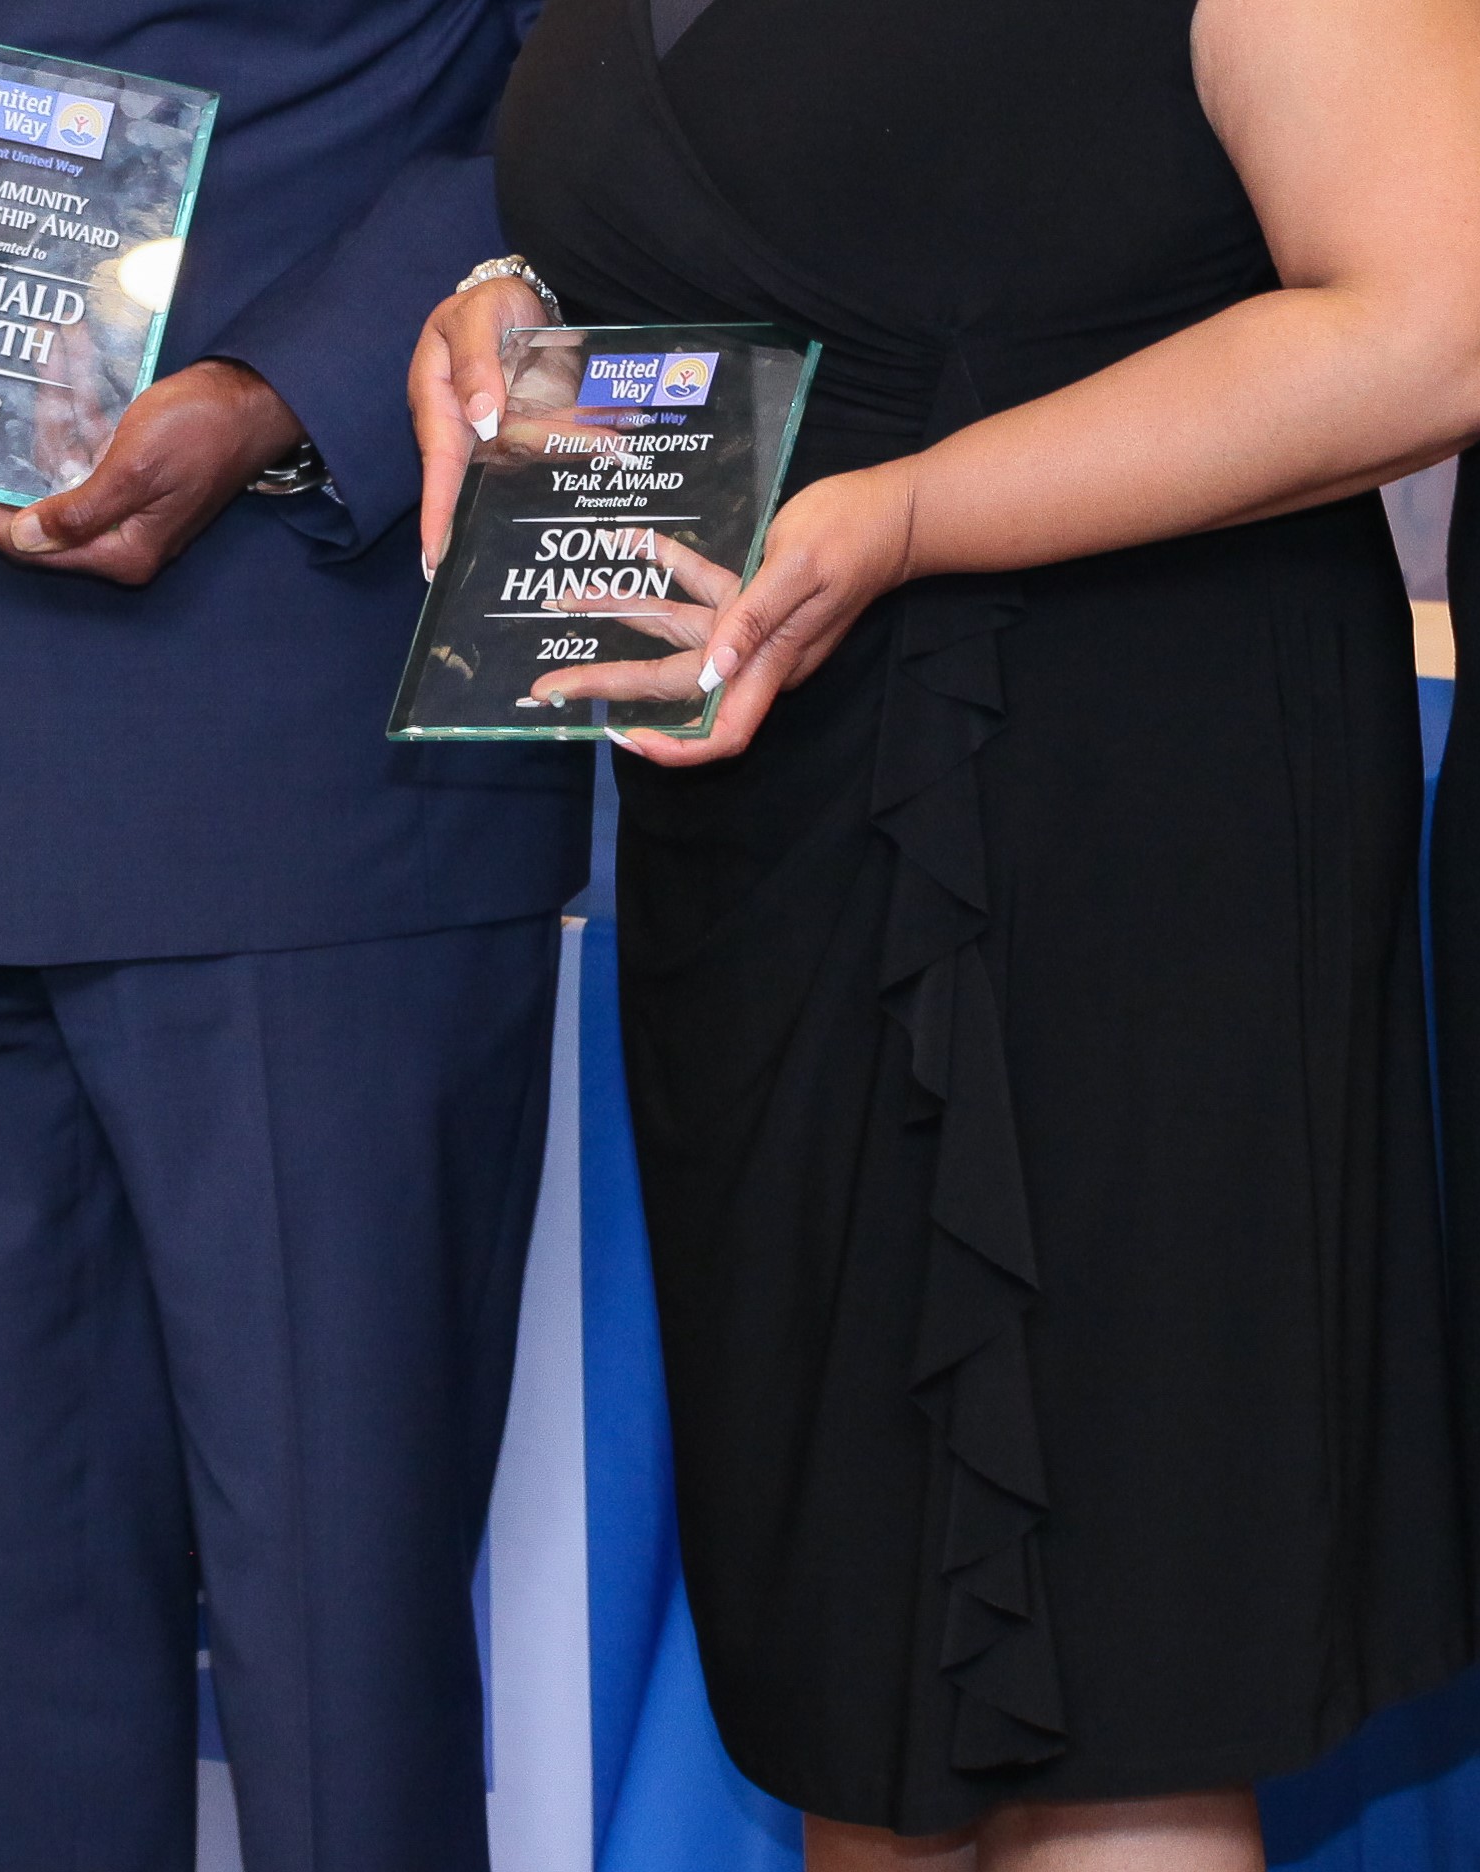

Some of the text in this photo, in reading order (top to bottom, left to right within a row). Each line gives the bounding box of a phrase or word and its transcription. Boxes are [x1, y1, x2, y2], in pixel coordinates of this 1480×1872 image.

[4, 110, 47, 142] Way
[12, 149, 54, 169] United
[55, 159, 84, 178] Way
[40, 213, 120, 249] AWARD
[33, 246, 47, 261] to
[590, 359, 660, 379] United
[612, 380, 653, 403] Way
[661, 412, 687, 426] Way
[544, 433, 714, 454] PHILANTHROPIST
[590, 456, 616, 471] OF
[552, 470, 684, 491] YEAR AWARD
[574, 494, 648, 508] Presented to
[535, 527, 657, 561] SONIA
[500, 567, 674, 600] HANSON
[536, 638, 599, 660] 2022
